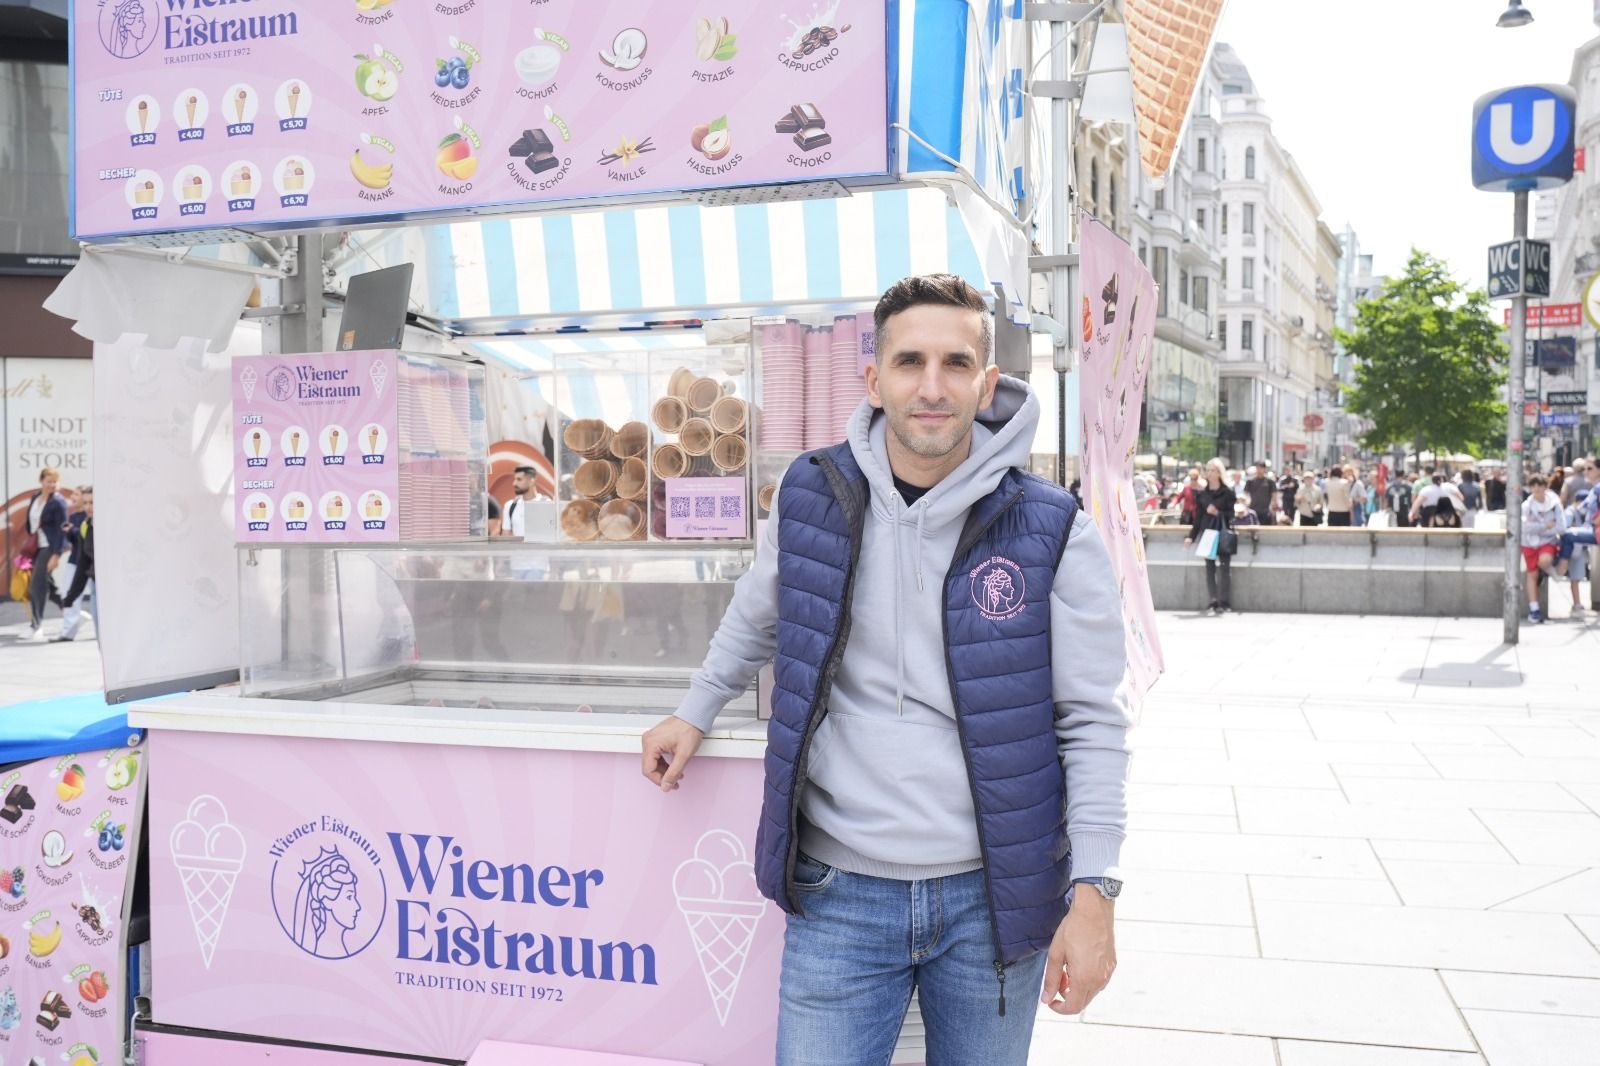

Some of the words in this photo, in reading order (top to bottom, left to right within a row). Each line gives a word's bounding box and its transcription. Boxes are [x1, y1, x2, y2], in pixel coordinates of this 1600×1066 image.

[435, 0, 475, 16] ERDBEER
[355, 10, 394, 26] ZITRONE
[164, 11, 298, 49] Eistraum
[544, 32, 569, 50] VEGAN
[164, 52, 211, 65] TRADITION
[213, 50, 232, 61] SEIT
[234, 48, 251, 57] 1972
[457, 42, 480, 62] VEGAN
[777, 47, 840, 73] CAPPUCCINO
[595, 66, 653, 91] KOKOSNUSS
[691, 66, 735, 83] PISTAZIE
[98, 88, 124, 101] TÜTE
[430, 86, 482, 109] HEIDELBEER
[516, 82, 558, 100] JOGHURT
[362, 106, 389, 116] APFEL
[461, 123, 480, 149] VEGAN
[552, 114, 570, 142] VEGAN
[1490, 98, 1555, 165] U
[371, 136, 395, 153] VEGAN
[686, 153, 744, 175] HASELNUSS
[786, 151, 832, 168] SCHOKO
[99, 167, 137, 180] BECHER
[506, 162, 537, 191] DUNKLE
[539, 157, 572, 191] SCHOKO
[606, 166, 647, 182] VANILLE
[358, 188, 395, 201] BANANE
[438, 182, 473, 196] MANGO
[1490, 243, 1519, 274] WC
[1526, 243, 1548, 272] WC
[296, 365, 349, 381] Wiener
[298, 382, 361, 399] Eistraum
[20, 417, 87, 433] LINDT
[20, 438, 87, 449] FLAGSHIP
[20, 453, 87, 469] STORE
[243, 480, 275, 489] BECHER
[969, 559, 991, 578] Wiener
[107, 795, 128, 806] APFEL
[56, 804, 81, 816] MANGO
[268, 821, 318, 860] Wiener
[319, 815, 381, 867] Eistraum
[88, 848, 126, 870] HEIDELBEER
[35, 864, 72, 886] KOKOSNUSS
[385, 831, 604, 909] Wiener
[75, 922, 113, 946] CAPPUCCINO
[395, 898, 659, 986] Eistraum
[25, 954, 52, 969] BANANE
[395, 971, 487, 994] TRADITION
[490, 981, 527, 998] SEIT
[530, 984, 564, 1002] 1972
[77, 1001, 108, 1018] ERDBEER
[36, 1030, 63, 1045] SCHOKO
